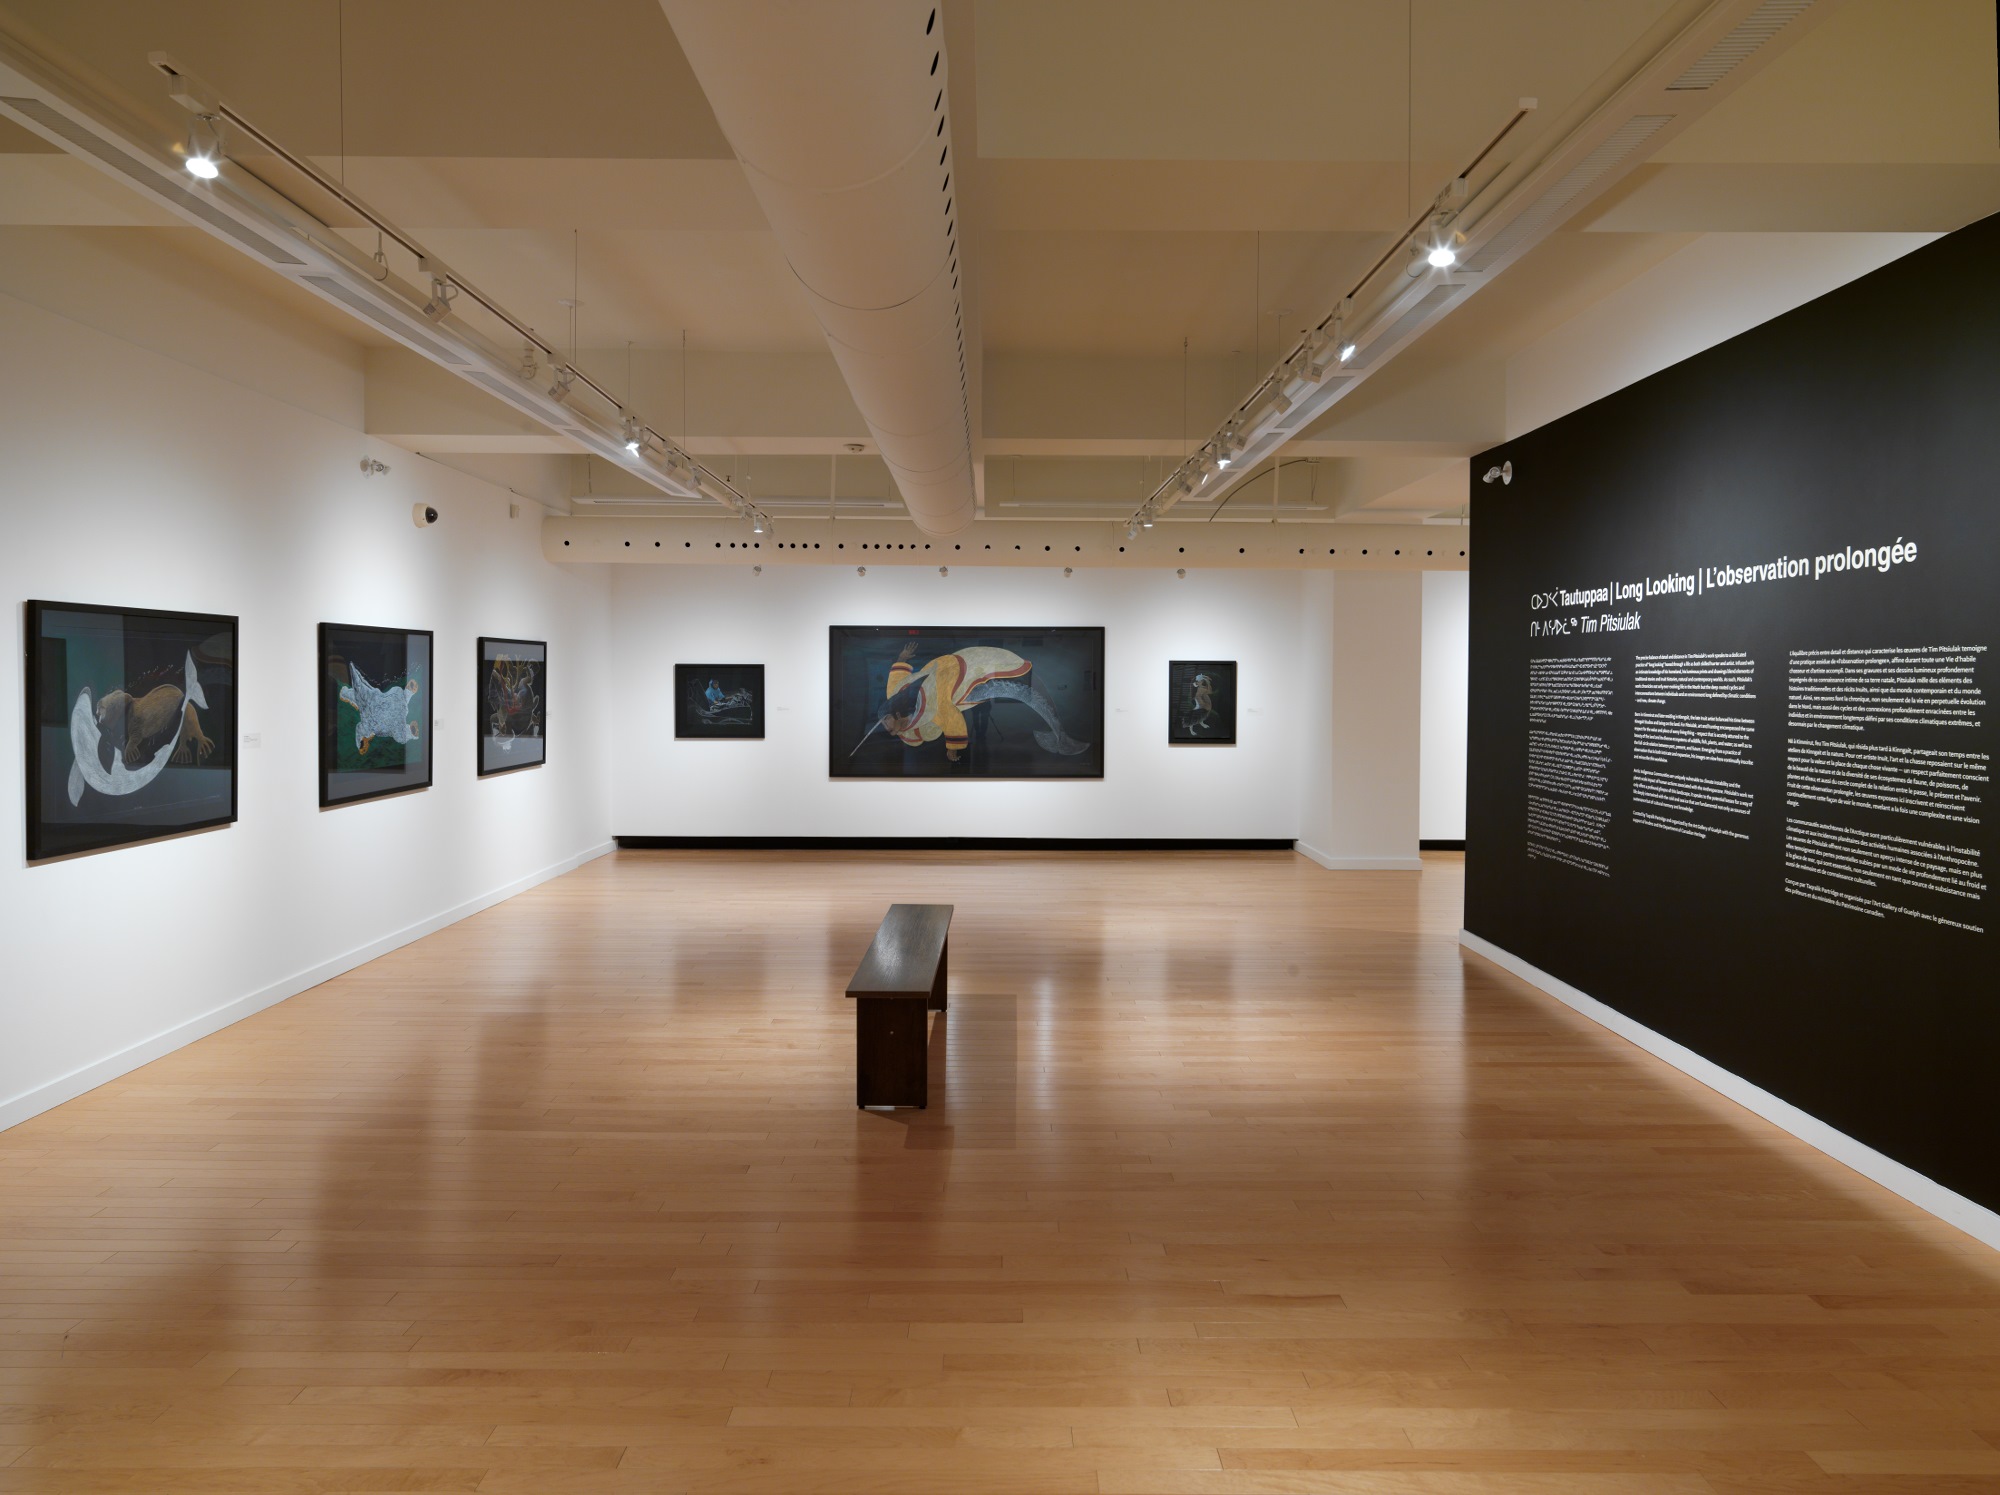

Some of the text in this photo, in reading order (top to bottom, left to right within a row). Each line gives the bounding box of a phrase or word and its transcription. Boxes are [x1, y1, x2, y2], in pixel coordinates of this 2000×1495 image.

[1560, 588, 1609, 608] Tautuppaa
[1616, 582, 1643, 603] Long
[1646, 572, 1695, 596] Looking
[1814, 536, 1918, 581] prolongée
[1581, 616, 1598, 634] Tim
[1599, 611, 1642, 632] Pitsiulak
[1964, 762, 1969, 770] le
[1964, 816, 1980, 824] vision
[1970, 871, 1983, 879] plus
[1967, 880, 1980, 889] froid
[1963, 924, 1984, 933] soutien
